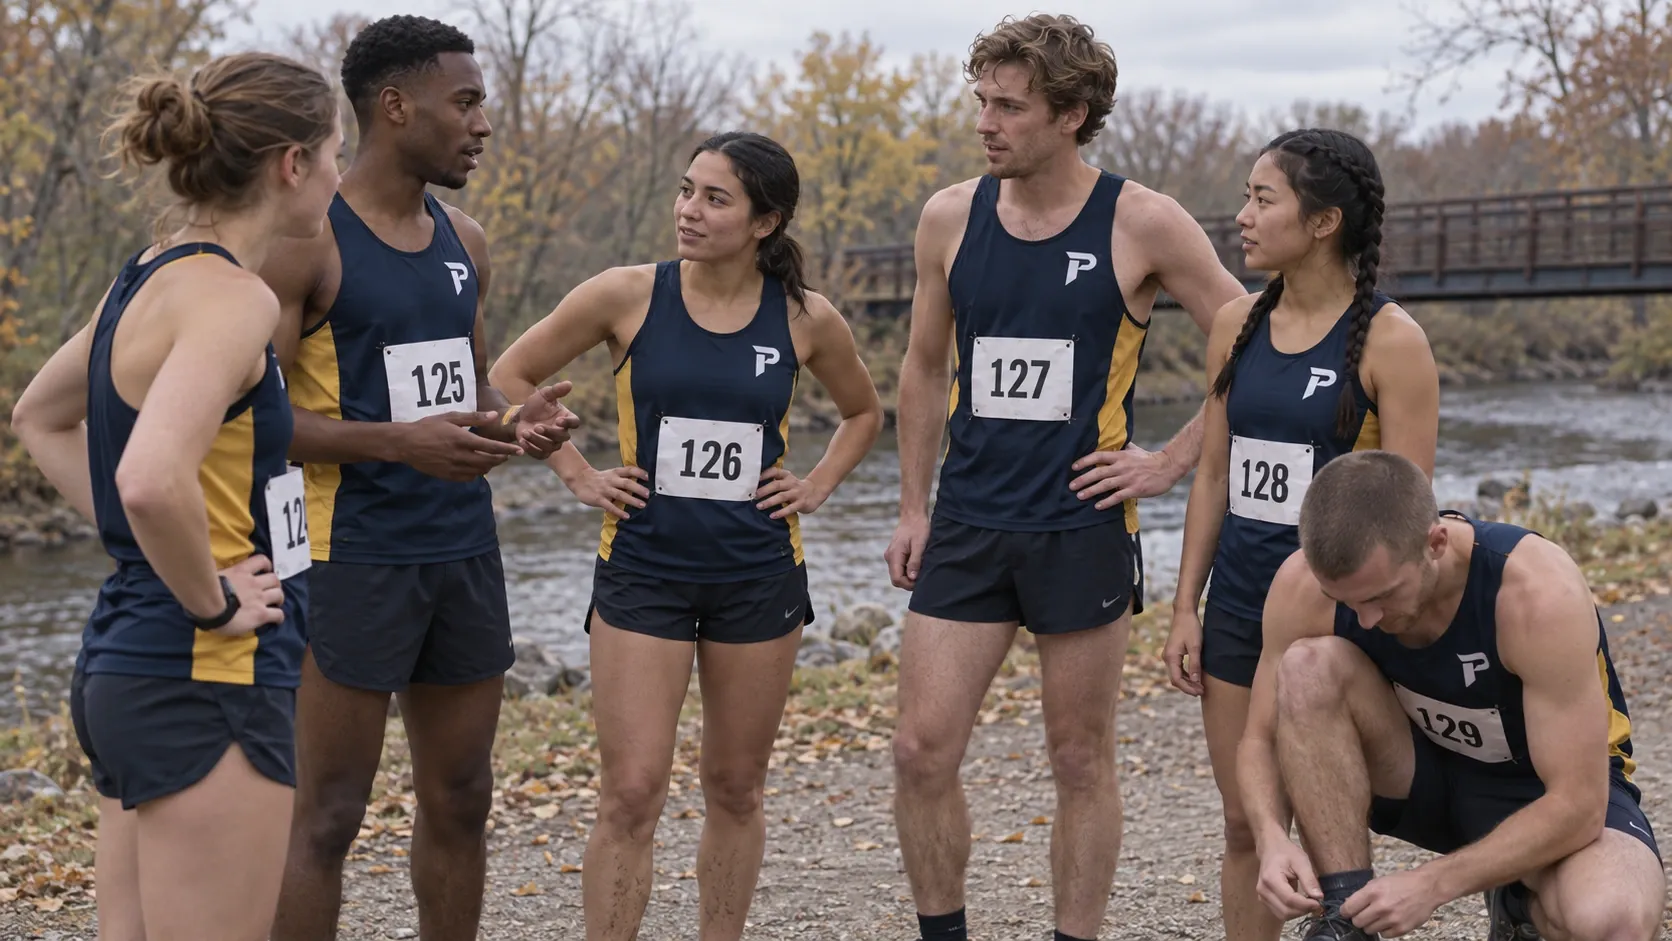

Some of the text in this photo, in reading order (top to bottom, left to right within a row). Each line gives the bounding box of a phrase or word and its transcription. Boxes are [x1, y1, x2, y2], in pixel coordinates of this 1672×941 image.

[411, 360, 465, 407] 125
[990, 358, 1051, 399] 127
[680, 439, 742, 481] 126
[1241, 458, 1289, 503] 128
[283, 495, 308, 549] 12
[1416, 707, 1483, 748] 129
